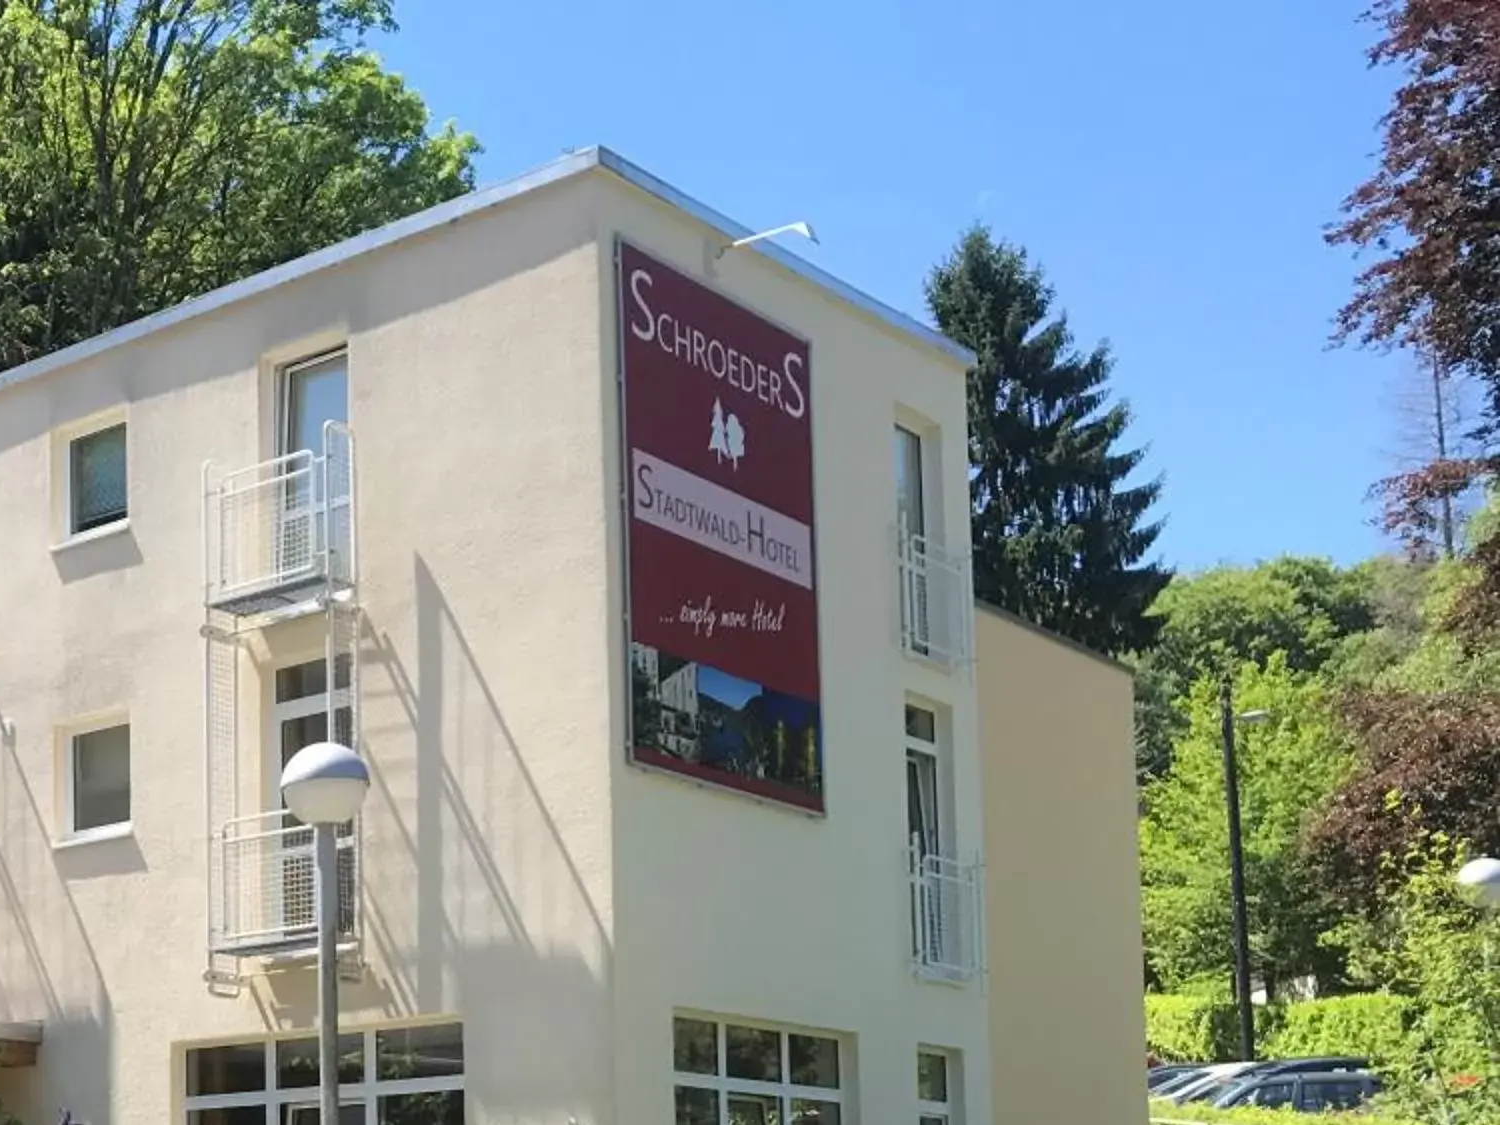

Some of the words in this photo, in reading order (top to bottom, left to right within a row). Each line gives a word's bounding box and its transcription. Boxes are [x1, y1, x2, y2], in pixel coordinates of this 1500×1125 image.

[679, 595, 716, 637] simply
[720, 609, 747, 628] more
[751, 599, 786, 632] Hotel
